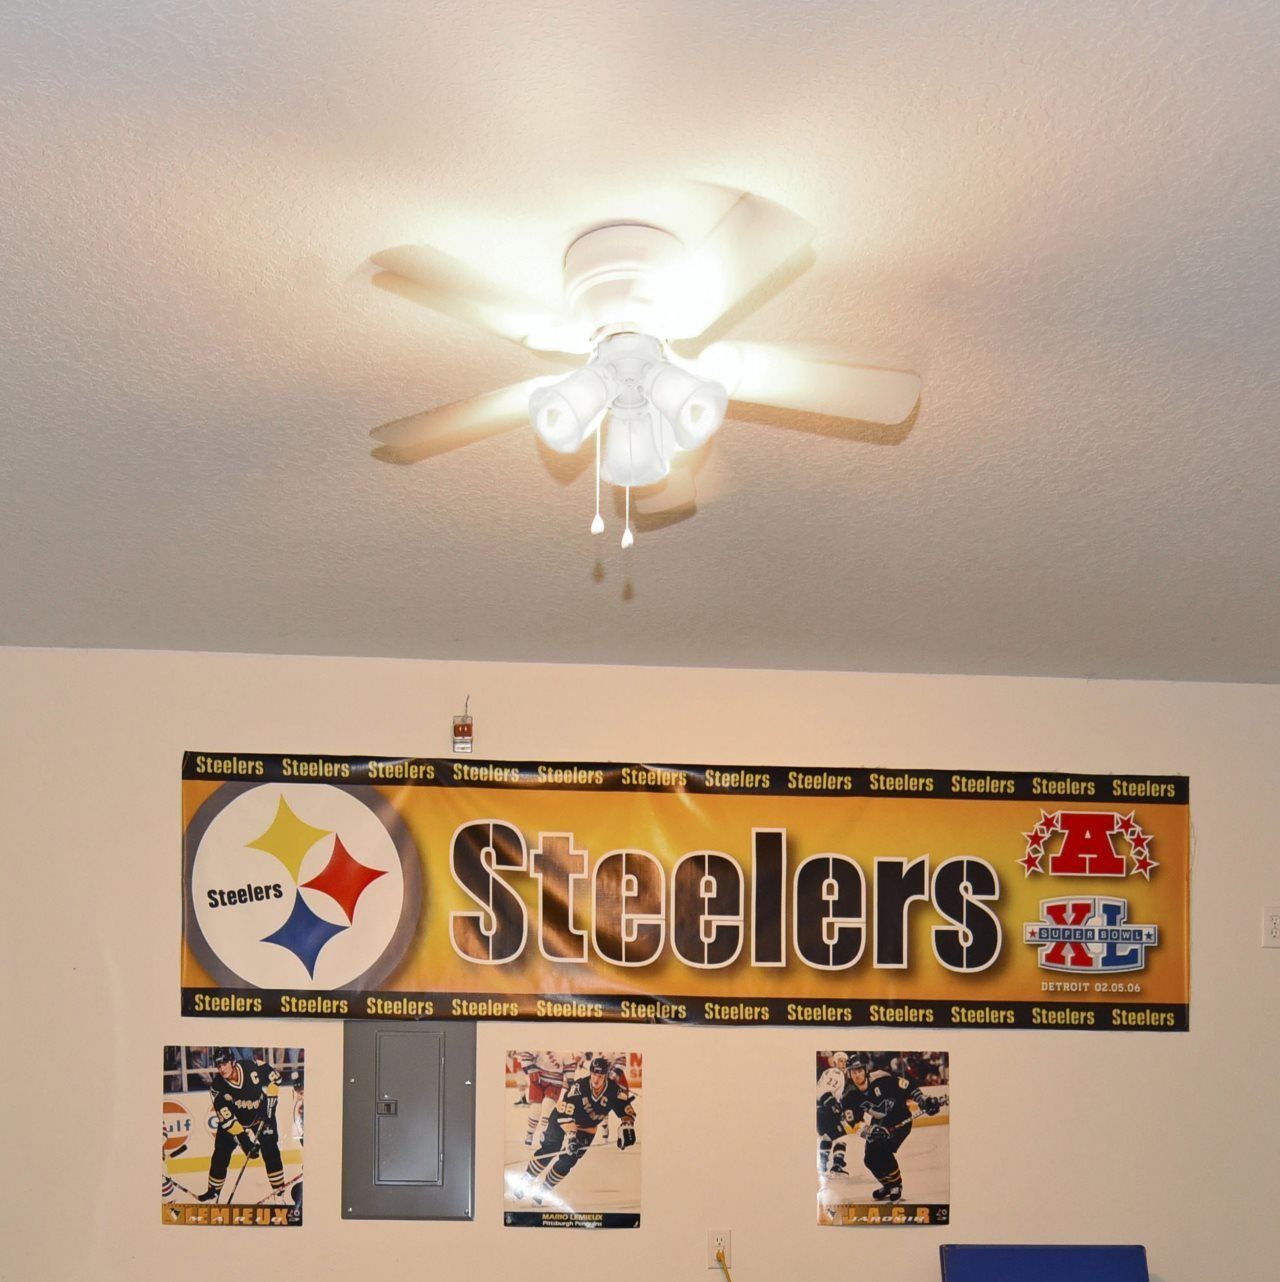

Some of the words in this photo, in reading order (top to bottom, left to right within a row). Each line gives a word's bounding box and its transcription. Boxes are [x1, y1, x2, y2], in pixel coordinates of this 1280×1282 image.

[196, 754, 263, 778] Steelers
[282, 756, 349, 780] Steelers
[368, 758, 434, 781] Steelers
[453, 760, 520, 783] Steelers
[537, 762, 604, 785] Steelers
[621, 764, 687, 787] Steelers
[704, 766, 770, 789] Steelers
[787, 768, 852, 791] Steelers
[869, 770, 934, 793] Steelers
[951, 772, 1015, 795] Steelers
[1032, 774, 1096, 797] Steelers
[1112, 776, 1176, 799] Steelers
[206, 881, 284, 909] Steelers
[449, 818, 1004, 974] Steelers
[1040, 929, 1094, 939] SUPER
[1099, 930, 1142, 940] BOWL
[1041, 982, 1090, 992] DETROIT
[1094, 983, 1141, 993] 02.05.06
[196, 993, 263, 1014] Steelers
[282, 994, 349, 1015] Steelers
[368, 996, 434, 1016] Steelers
[453, 997, 520, 1018] Steelers
[537, 998, 604, 1019] Steelers
[621, 999, 687, 1020] Steelers
[704, 1001, 770, 1021] Steelers
[787, 1002, 852, 1022] Steelers
[869, 1003, 934, 1023] Steelers
[951, 1004, 1015, 1025] Steelers
[1032, 1005, 1096, 1026] Steelers
[1112, 1007, 1176, 1027] Steelers
[185, 1207, 289, 1225] LEMIEUX
[841, 1206, 930, 1224] JAGR
